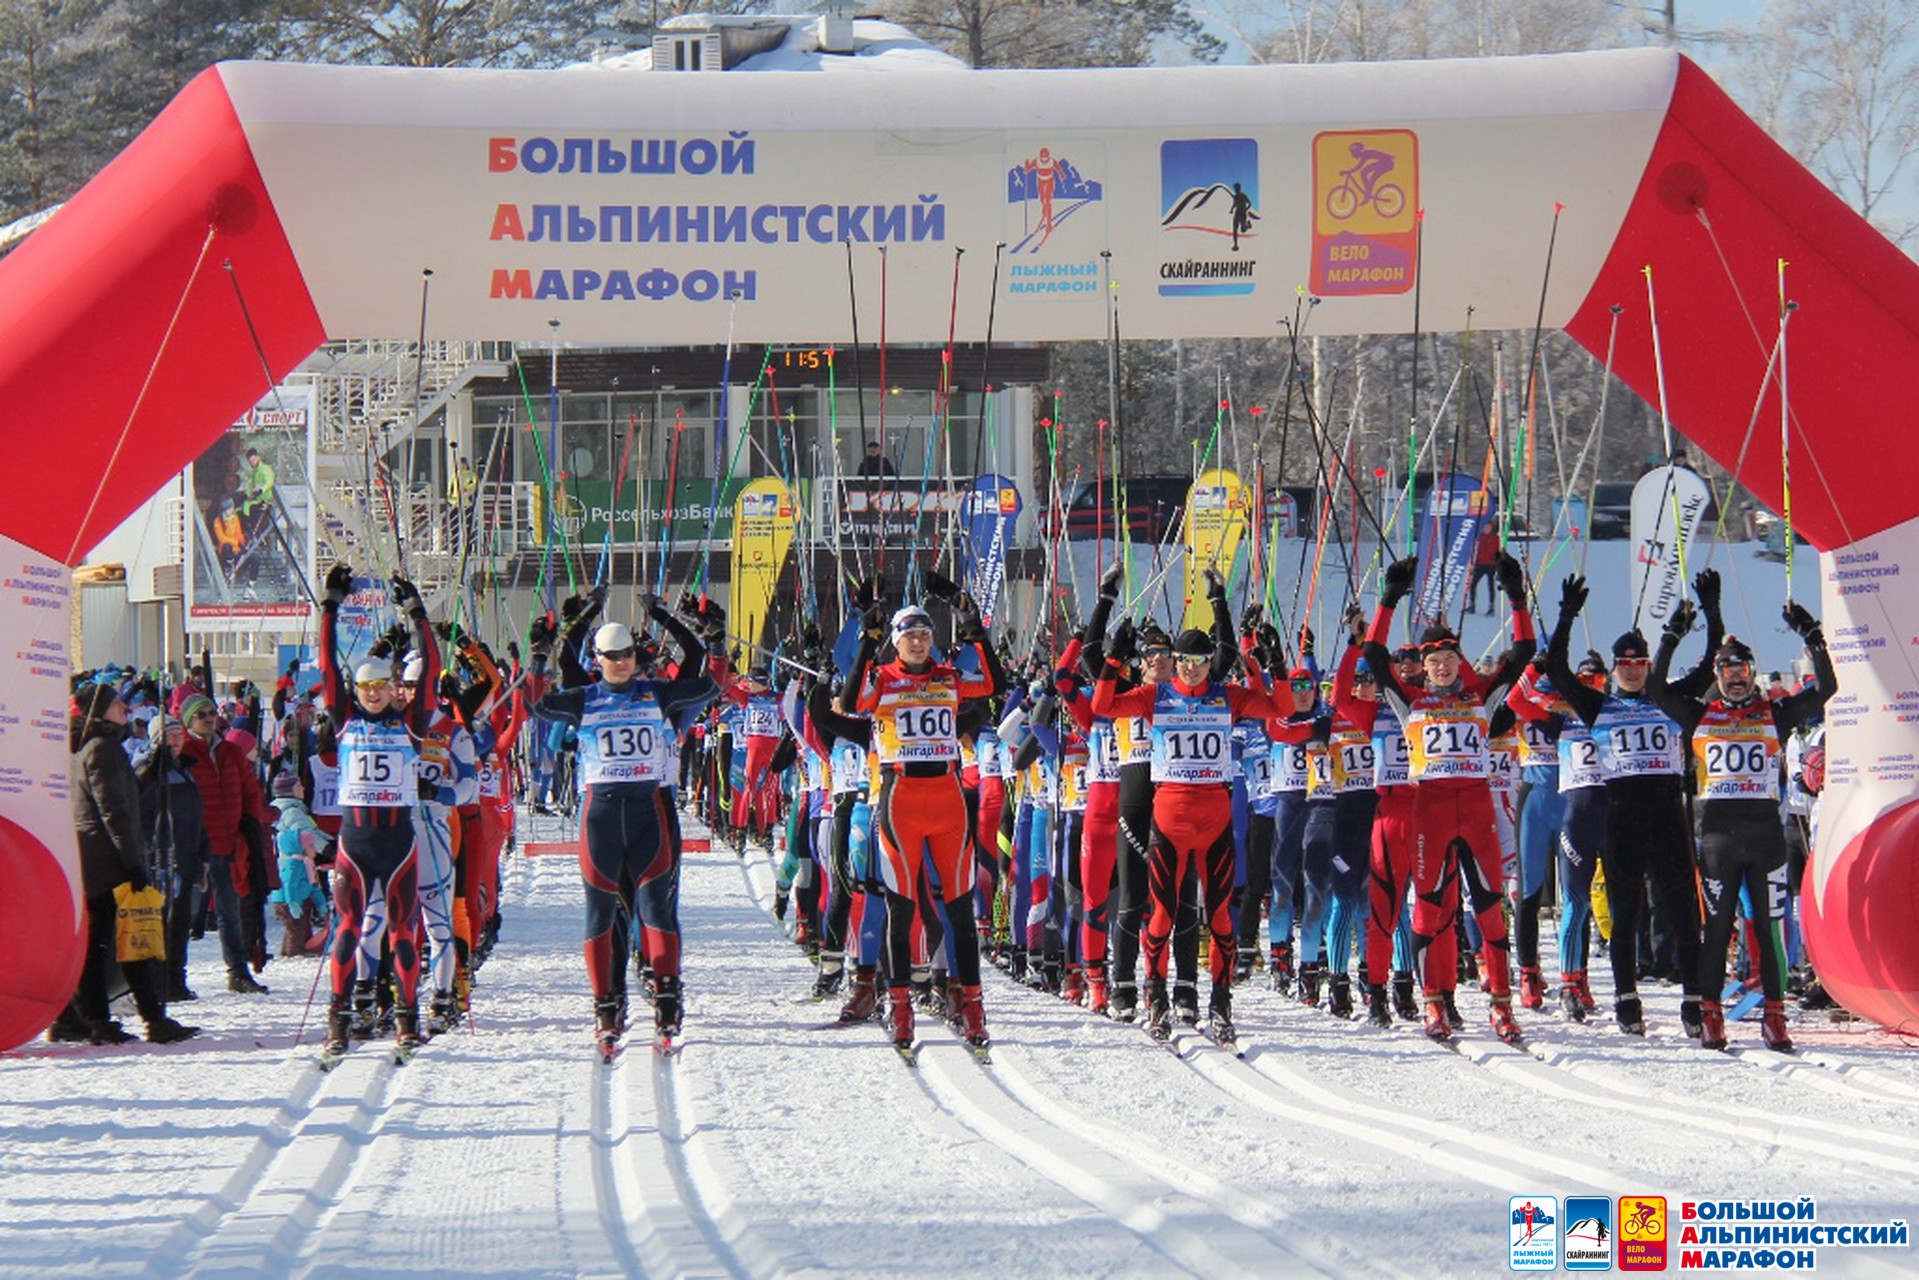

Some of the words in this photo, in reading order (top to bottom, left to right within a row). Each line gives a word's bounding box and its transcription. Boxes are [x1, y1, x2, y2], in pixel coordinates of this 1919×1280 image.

[488, 130, 755, 175] БОЛЬШОЙ
[489, 193, 945, 244] АЛЬПИНИСТСКИЙ
[1329, 245, 1369, 261] ВЕЛО
[1010, 261, 1098, 277] ЛЫЖНЫЙ
[1160, 259, 1256, 279] СКАЙРАННИНГ
[1328, 267, 1404, 282] МАРАФОН
[489, 267, 757, 301] МАРАФОН
[1010, 281, 1097, 293] МАРАФОН
[899, 708, 952, 738] 160
[600, 727, 654, 757] 130
[1168, 731, 1221, 759] 110
[1425, 724, 1480, 754] 214
[1581, 741, 1597, 765] 2
[1615, 725, 1667, 753] 116
[358, 754, 391, 782] 15
[1707, 743, 1765, 773] 206
